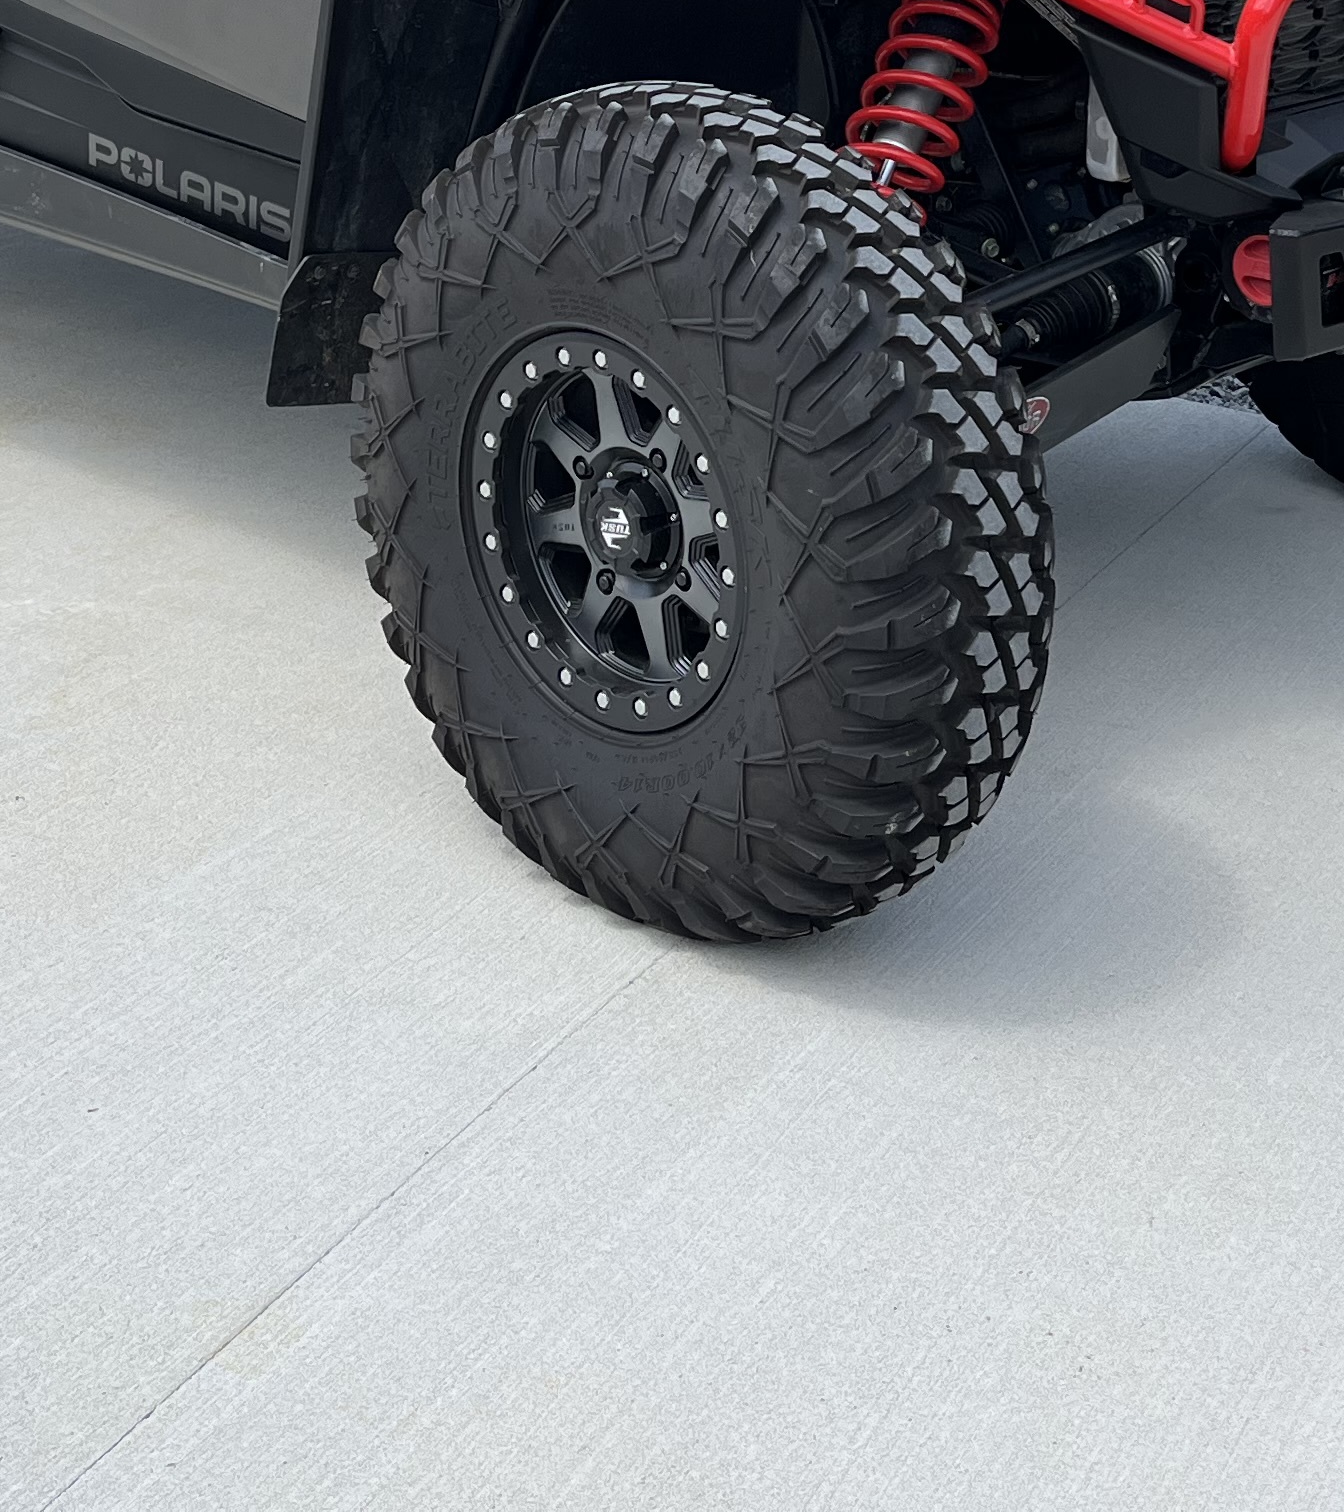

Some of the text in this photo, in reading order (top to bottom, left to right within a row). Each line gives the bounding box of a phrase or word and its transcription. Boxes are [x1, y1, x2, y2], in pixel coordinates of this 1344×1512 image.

[88, 132, 292, 242] POLARIS
[426, 295, 518, 502] TERRABITE
[600, 521, 630, 535] TUSK
